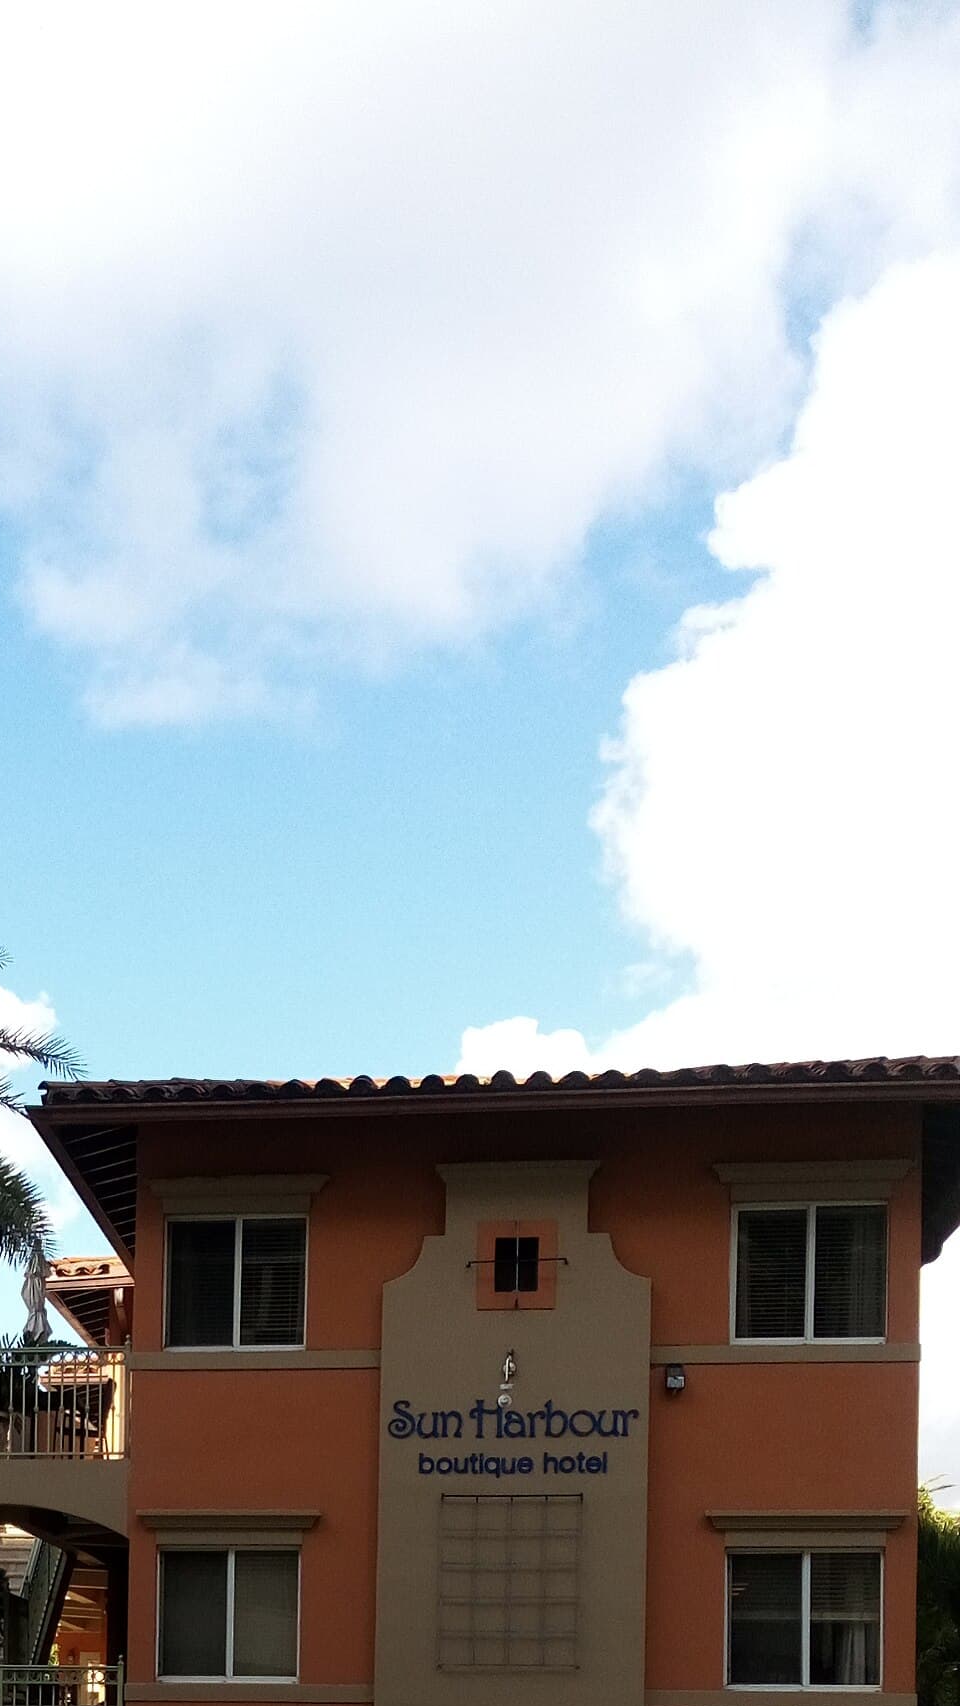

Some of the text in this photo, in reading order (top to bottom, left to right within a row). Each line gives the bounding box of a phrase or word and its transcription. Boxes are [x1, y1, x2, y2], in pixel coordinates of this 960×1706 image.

[387, 1399, 639, 1439] Sun Harbour
[418, 1451, 608, 1478] boutique hotel
